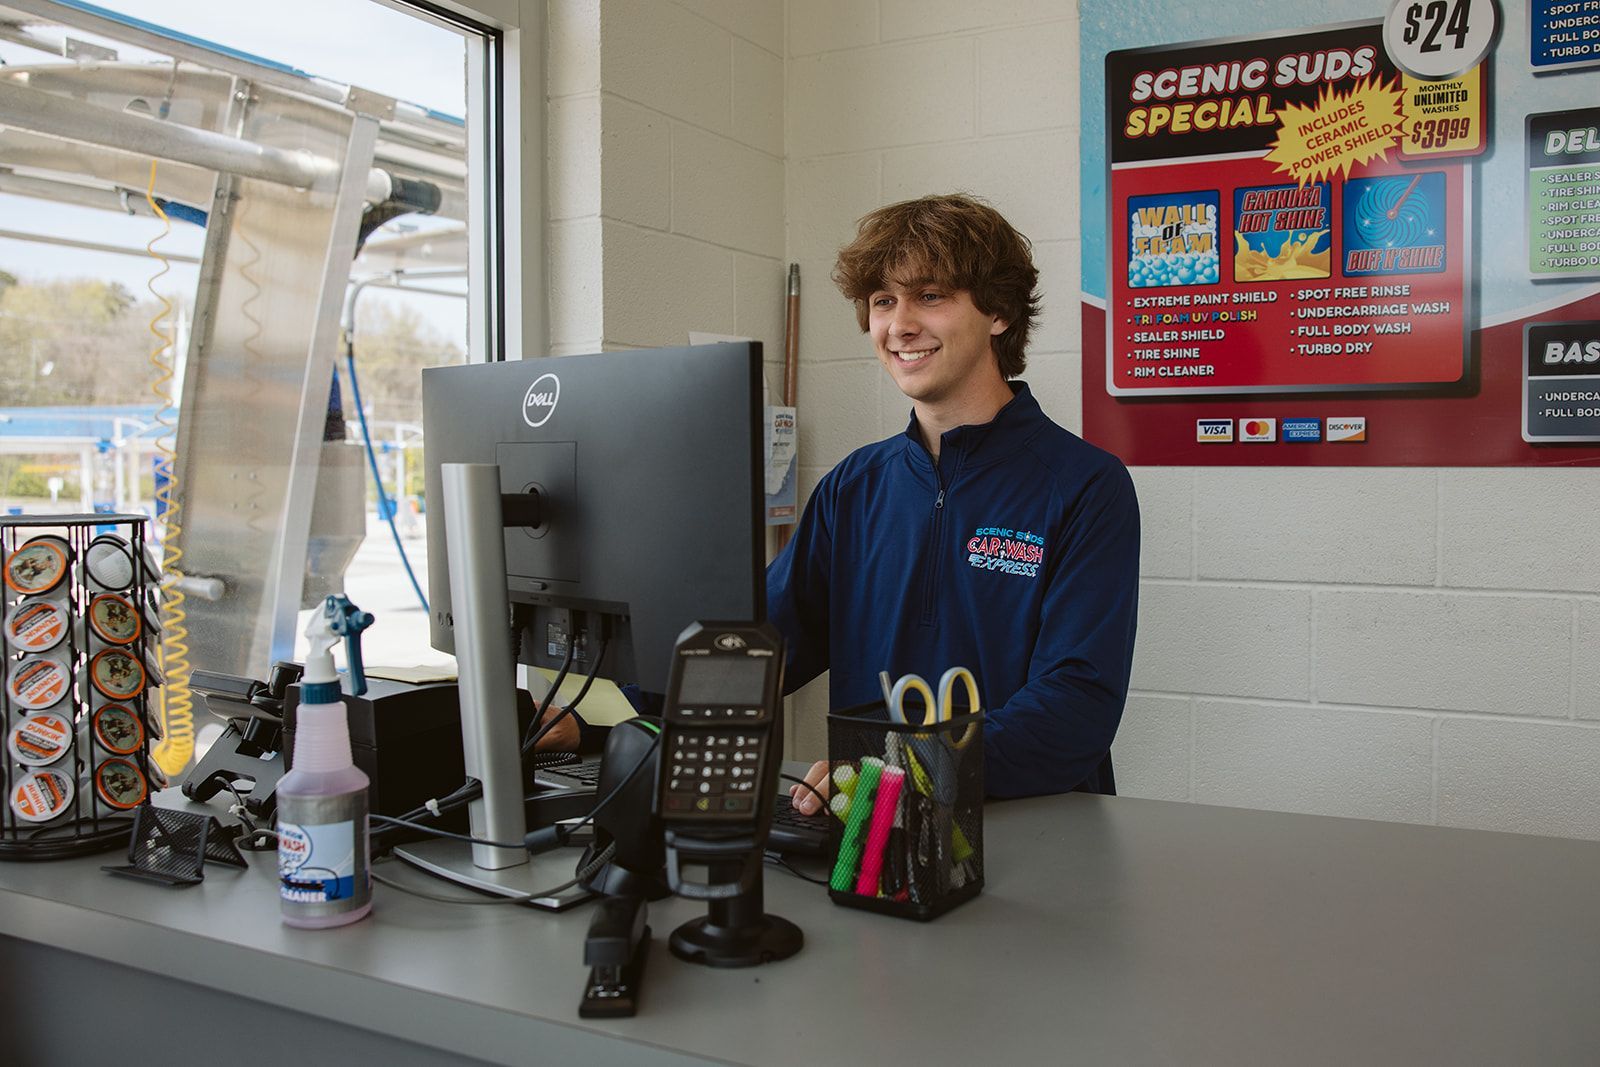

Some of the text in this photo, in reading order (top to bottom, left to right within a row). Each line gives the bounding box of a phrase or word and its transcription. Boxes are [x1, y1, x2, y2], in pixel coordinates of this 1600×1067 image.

[1550, 1, 1600, 15] SPOT FR
[1403, 0, 1471, 53] $24
[1550, 15, 1600, 29] UNDERC
[1550, 32, 1579, 43] FULL
[1550, 45, 1590, 57] TURBO
[1131, 47, 1376, 101] SCENIC SUDS
[1419, 82, 1463, 93] MONTHLY
[1414, 90, 1468, 106] UNLIMITED
[1125, 95, 1277, 137] SPECIAL
[1422, 105, 1460, 114] WASHES
[1298, 100, 1365, 137] INCLUDES
[1306, 116, 1369, 150] CERAMIC
[1292, 123, 1393, 173] POWER SHIELD
[1548, 172, 1591, 183] SEALER
[1243, 186, 1321, 211] CARNUBA
[1549, 187, 1574, 197] TIRE
[1548, 202, 1568, 211] RIM
[1138, 204, 1211, 228] WALL
[1239, 208, 1325, 233] HOT SHINE
[1547, 215, 1577, 225] SPOT
[1162, 221, 1185, 241] OF
[1135, 233, 1213, 256] FOAM
[1548, 244, 1576, 254] FULL
[1347, 250, 1382, 271] BUFF
[1399, 247, 1442, 267] SHINE
[1548, 256, 1600, 268] TURBO D
[1134, 291, 1278, 308] EXTREME PAINT SHIELD
[1297, 285, 1410, 300] SPOT FREE RINSE
[1297, 302, 1450, 318] UNDERCARRIAGE WASH
[1134, 310, 1257, 325] TRI FOAM UV POLISH
[1134, 329, 1225, 343] SEALER SHIELD
[1298, 322, 1411, 336] FULL BODY WASH
[1134, 348, 1200, 360] TIRE SHINE
[1297, 342, 1373, 355] TURBO DRY
[1134, 365, 1215, 378] RIM CLEANER
[527, 392, 554, 407] DELL
[1545, 409, 1573, 417] FULL
[1203, 426, 1227, 435] VISA
[1282, 422, 1318, 430] AMERICAN
[1328, 423, 1363, 431] DISCOVER
[1289, 430, 1320, 438] EXPRESS
[975, 527, 1045, 545] SCENIC SUDS
[967, 537, 1044, 563] CAR WASH
[968, 553, 1039, 577] EXPRESS
